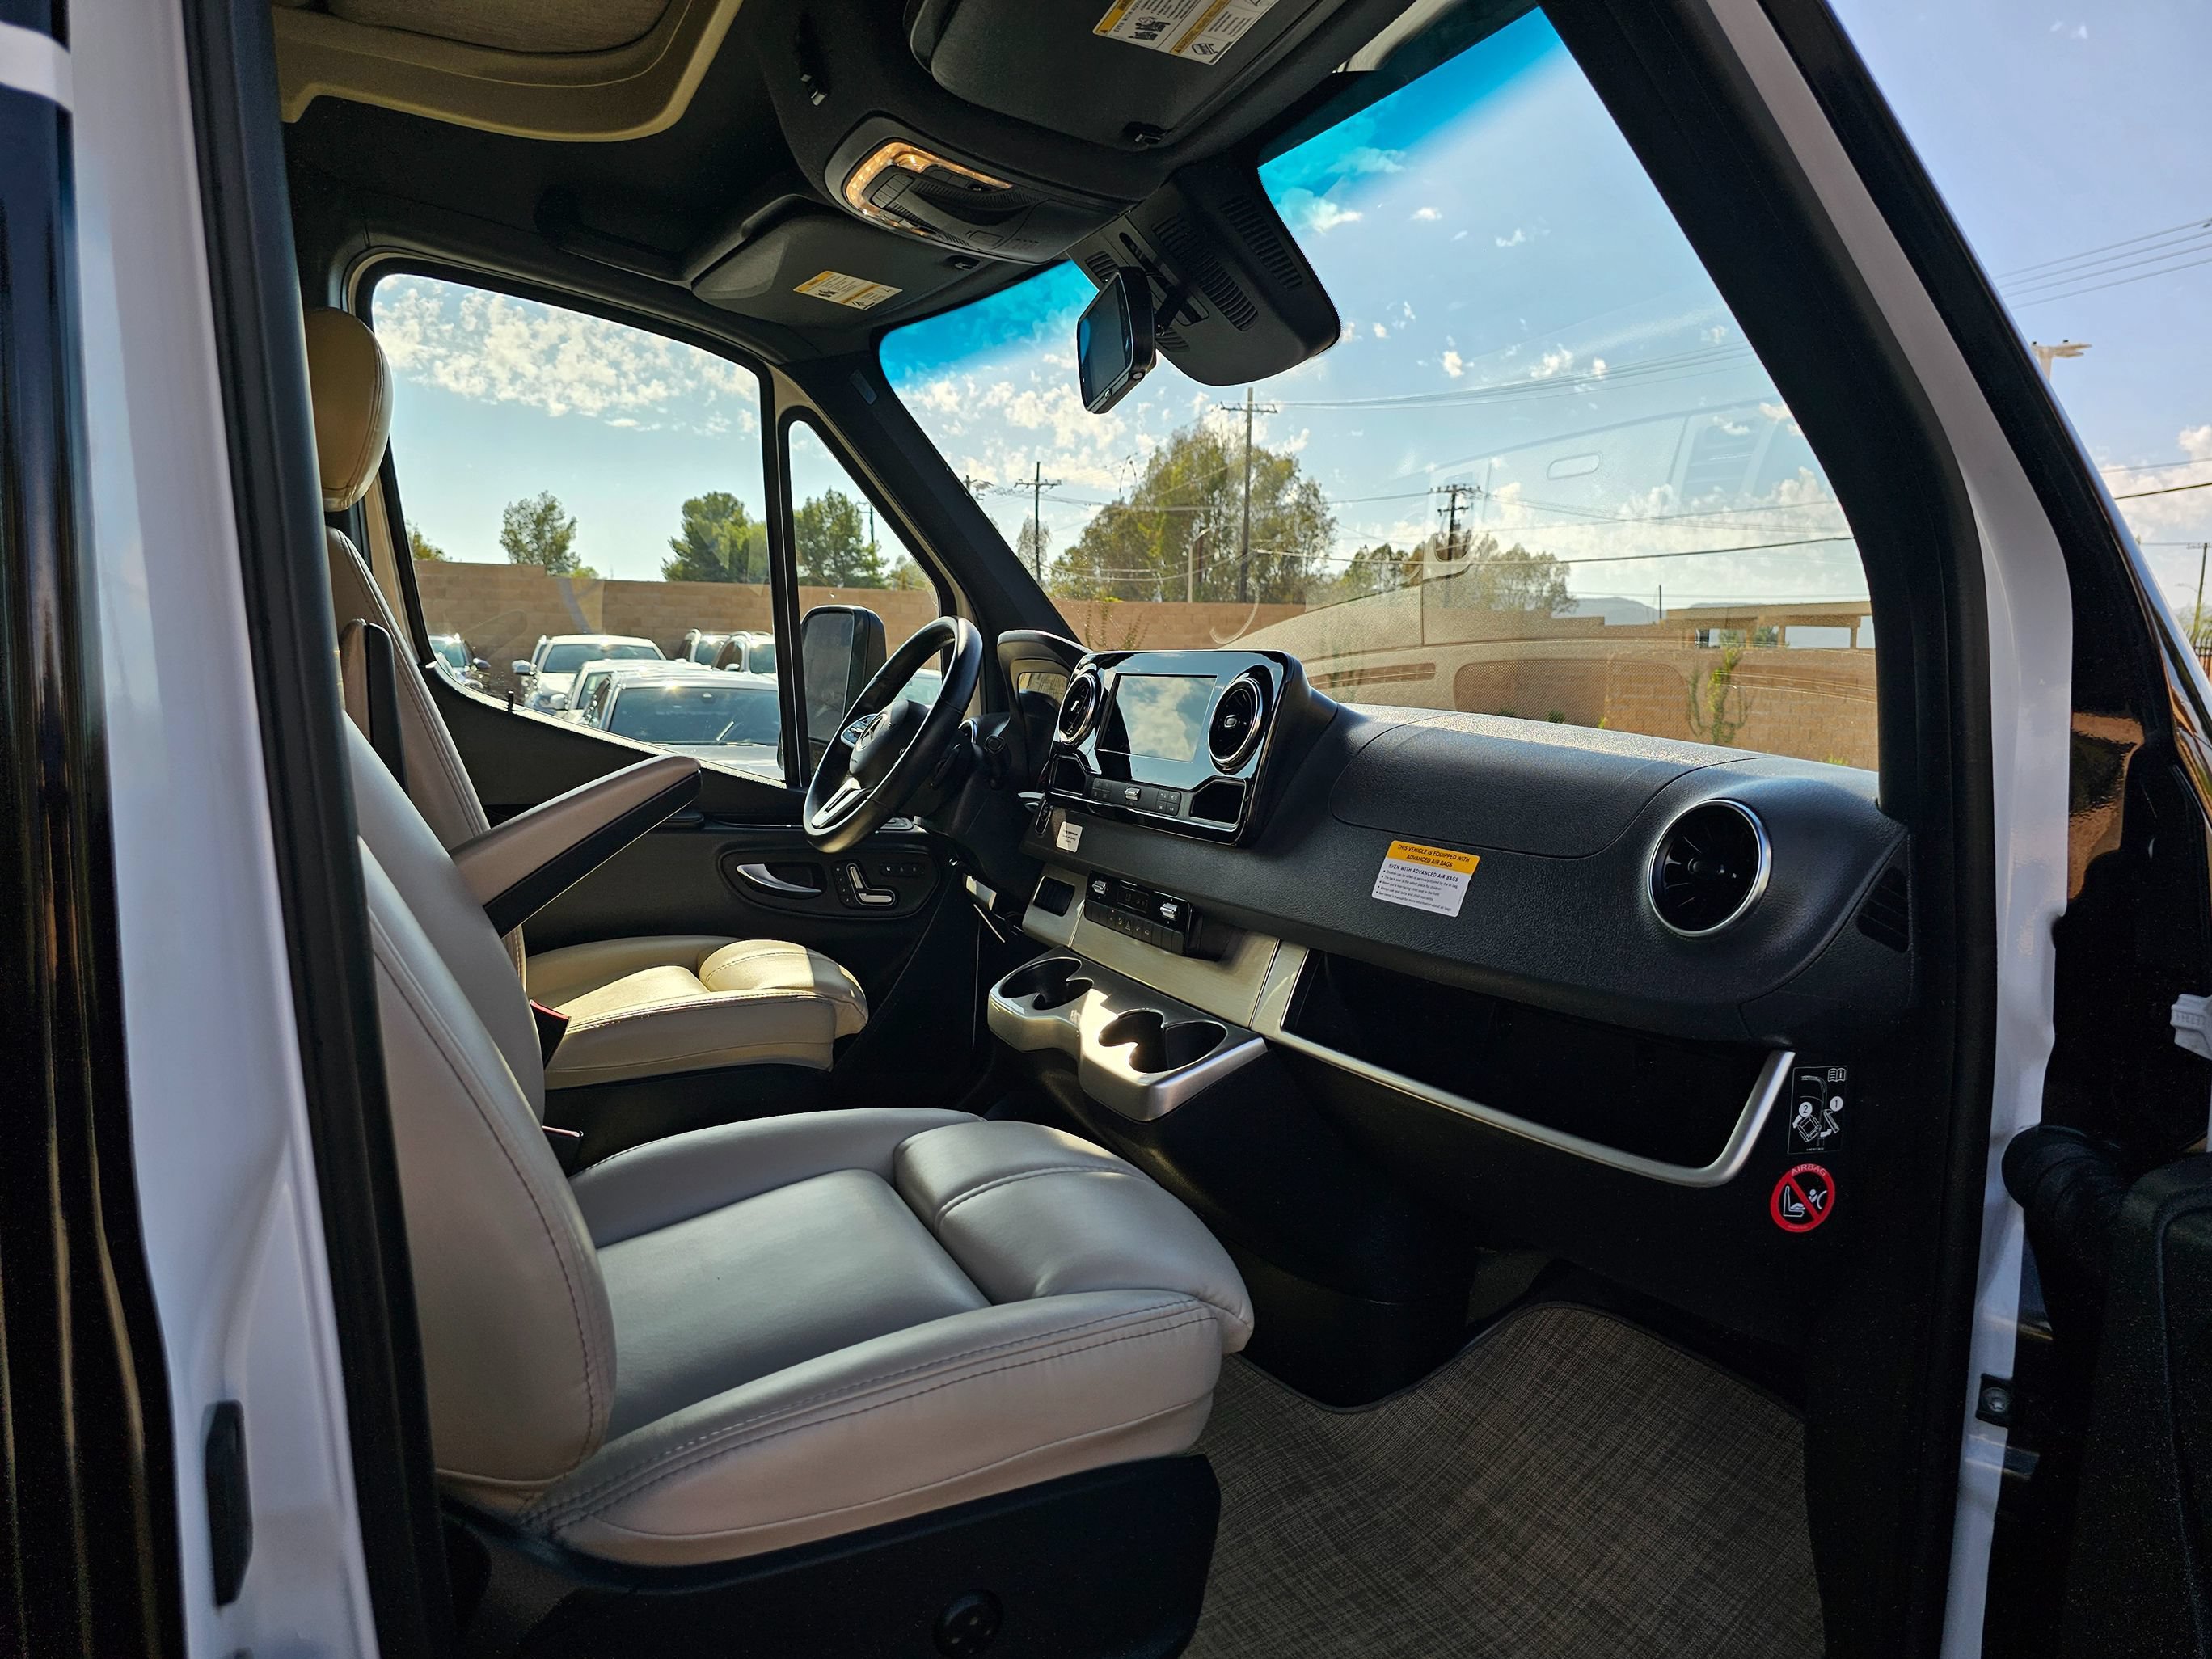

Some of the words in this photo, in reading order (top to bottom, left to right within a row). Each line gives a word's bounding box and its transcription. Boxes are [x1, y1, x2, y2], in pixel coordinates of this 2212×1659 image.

[1408, 846, 1427, 855] VEHICLE
[1433, 851, 1457, 860] EQUIPPED
[1407, 855, 1431, 863] ADVANCED
[1412, 868, 1437, 877] ADVANCED
[1834, 1100, 1838, 1108] 1
[1803, 1104, 1809, 1114] 2
[1791, 1164, 1827, 1176] AIRBAG
